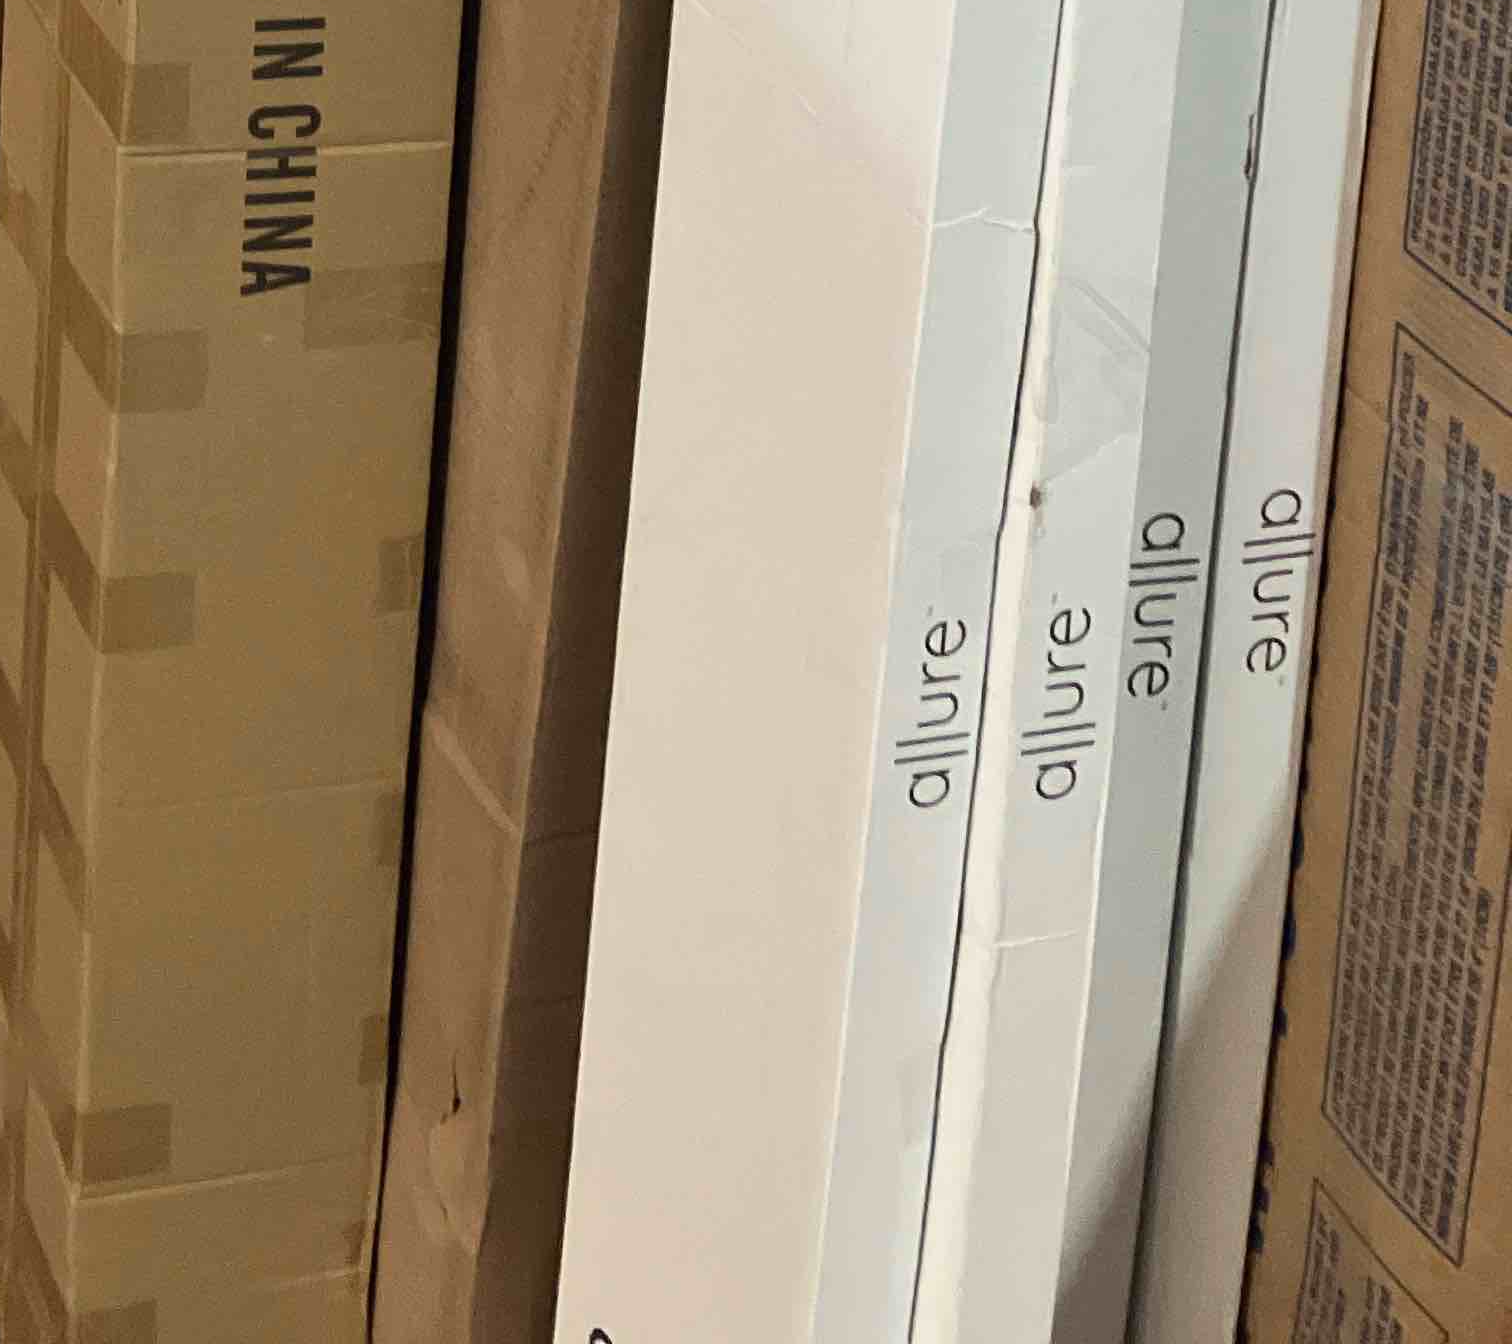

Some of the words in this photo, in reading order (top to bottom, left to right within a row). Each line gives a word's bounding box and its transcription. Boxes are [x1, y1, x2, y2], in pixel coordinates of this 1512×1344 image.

[252, 16, 326, 80] IN
[240, 105, 322, 297] CHINA
[1127, 513, 1200, 697] allure
[1242, 488, 1316, 673] allure
[894, 619, 970, 808] allure
[1021, 608, 1096, 800] allure
